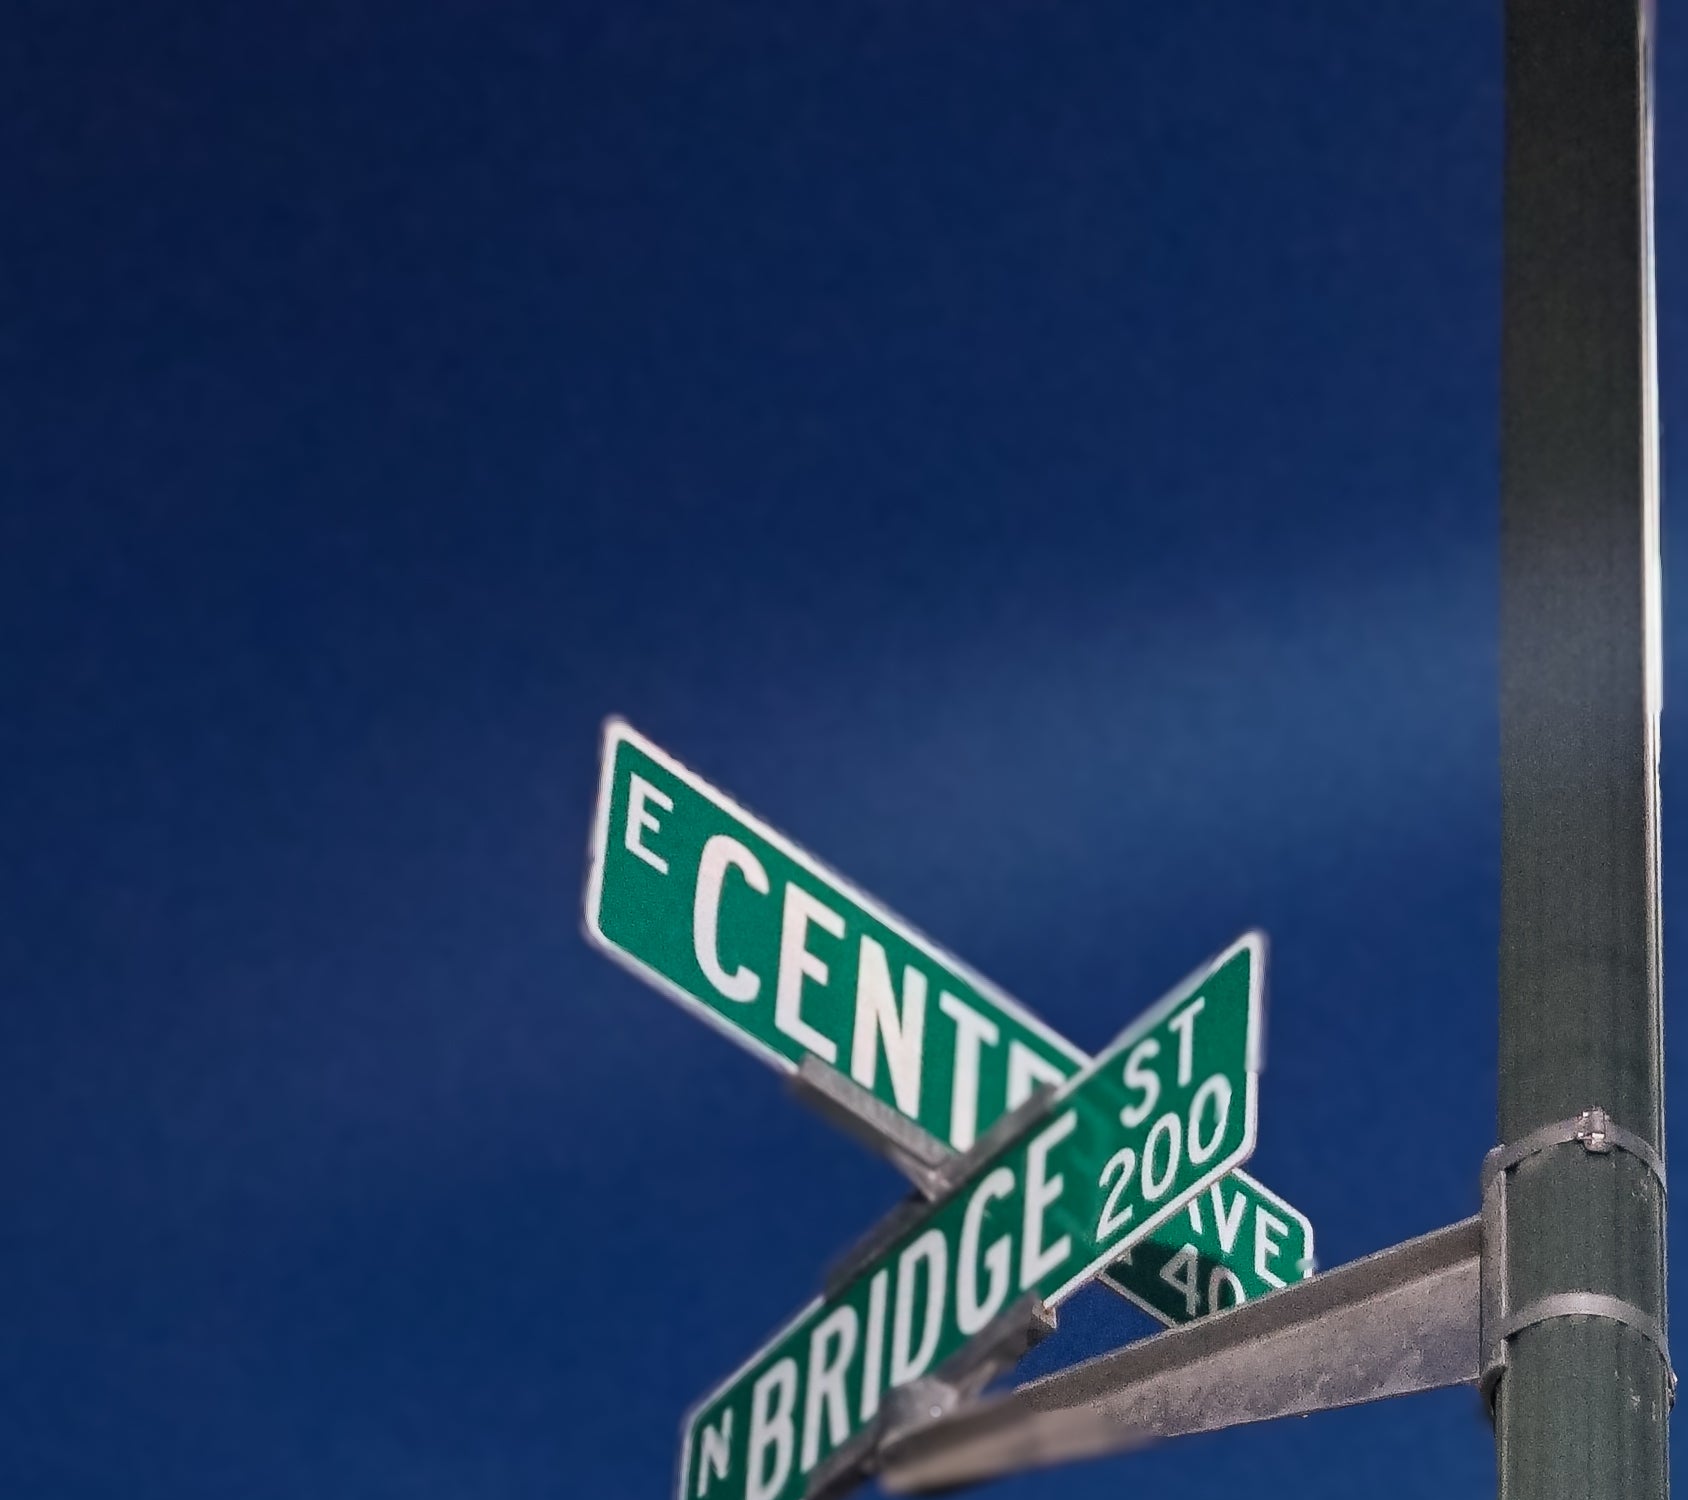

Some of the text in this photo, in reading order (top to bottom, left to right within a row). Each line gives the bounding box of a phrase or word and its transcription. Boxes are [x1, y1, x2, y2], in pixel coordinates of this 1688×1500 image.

[625, 772, 675, 875] E
[1096, 1073, 1233, 1243] 200
[696, 1407, 733, 1498] N
[1119, 996, 1206, 1129] ST
